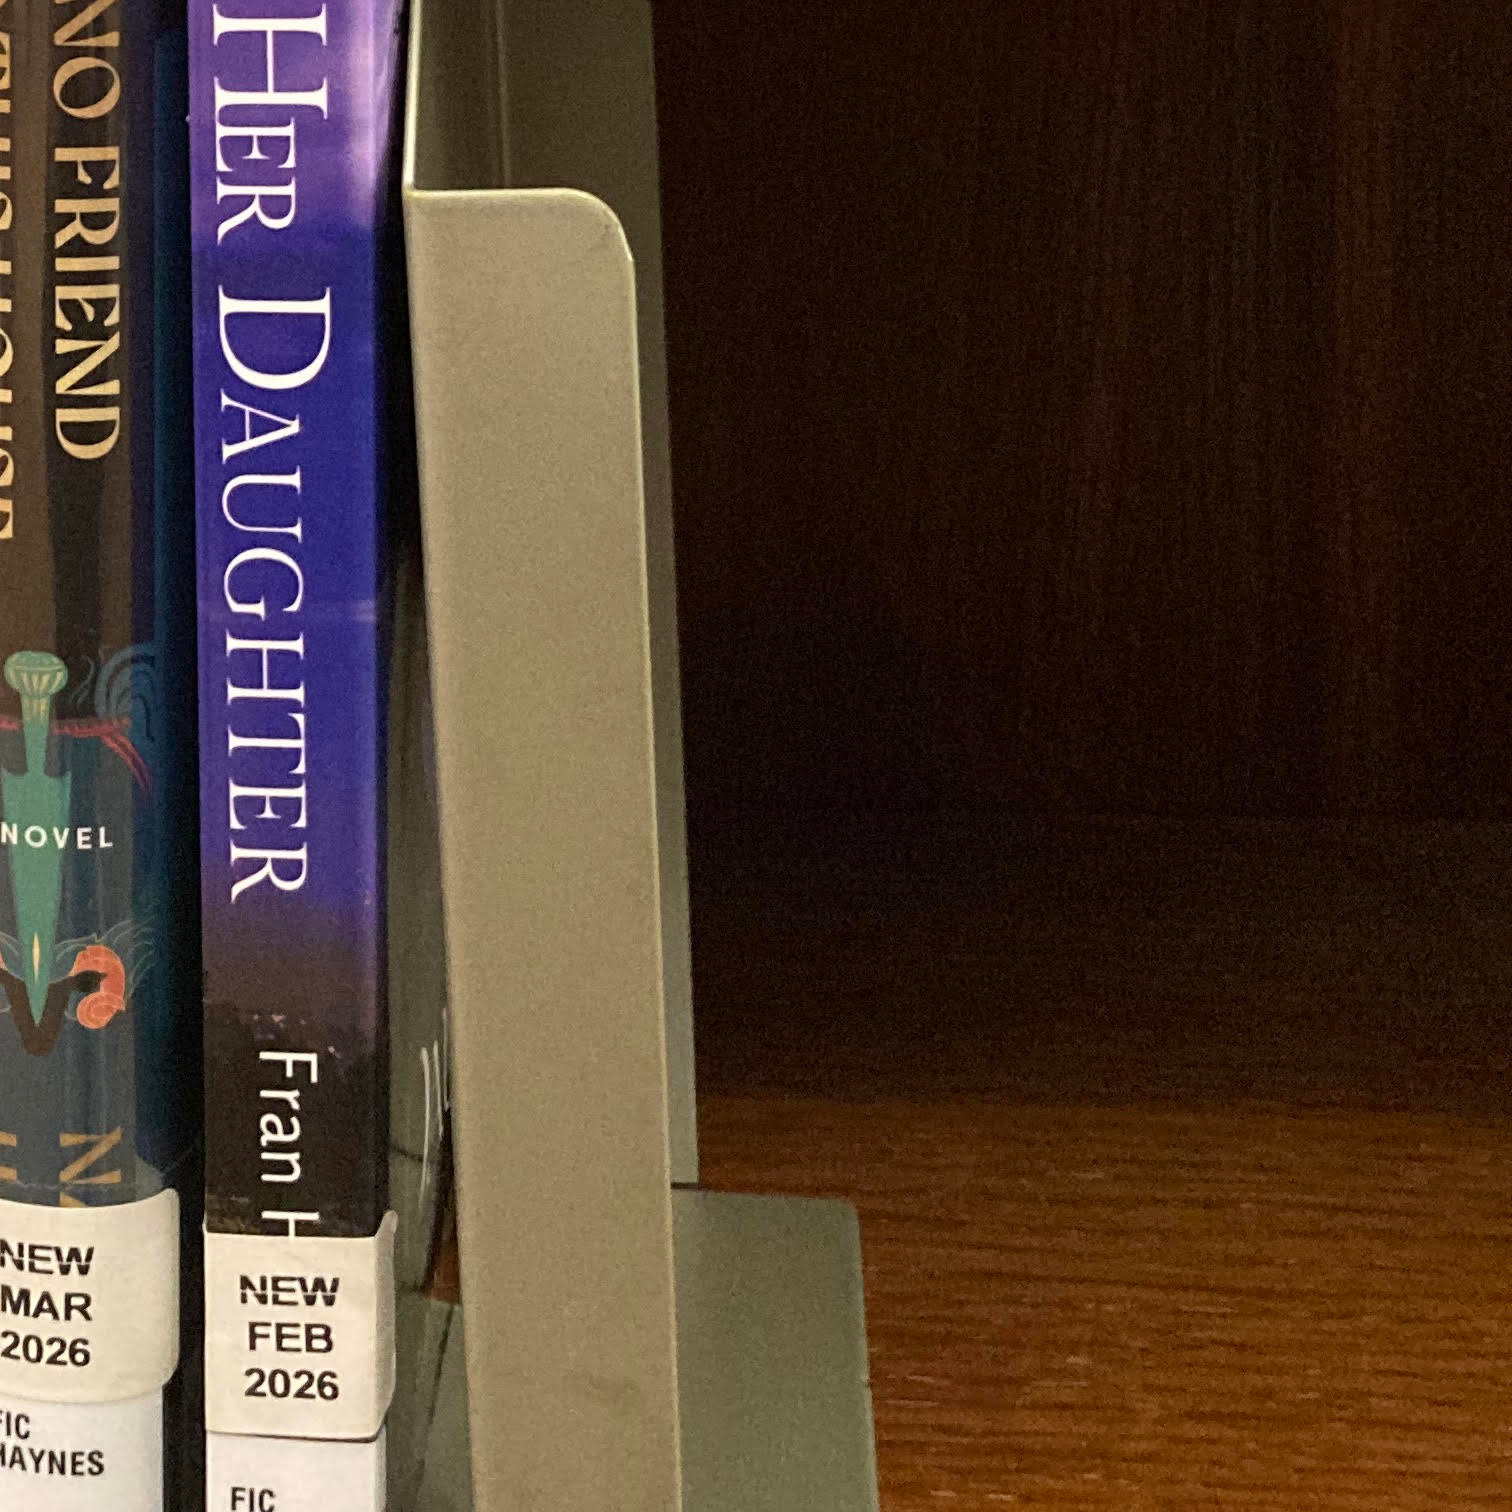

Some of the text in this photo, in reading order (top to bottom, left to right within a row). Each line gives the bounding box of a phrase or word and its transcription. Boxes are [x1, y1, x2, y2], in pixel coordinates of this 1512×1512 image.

[53, 145, 122, 460] FRIEND
[212, 3, 332, 903] HER DAUGHTER
[0, 820, 113, 850] NOVEL
[259, 1050, 318, 1182] Fran
[59, 1126, 123, 1205] N
[0, 1238, 94, 1276] NEW
[0, 1284, 93, 1322] MAR
[239, 1274, 340, 1307] NEW
[0, 1330, 91, 1367] 2026
[248, 1321, 333, 1353] FEB
[244, 1367, 339, 1401] 2026
[230, 1486, 275, 1512] FIC
